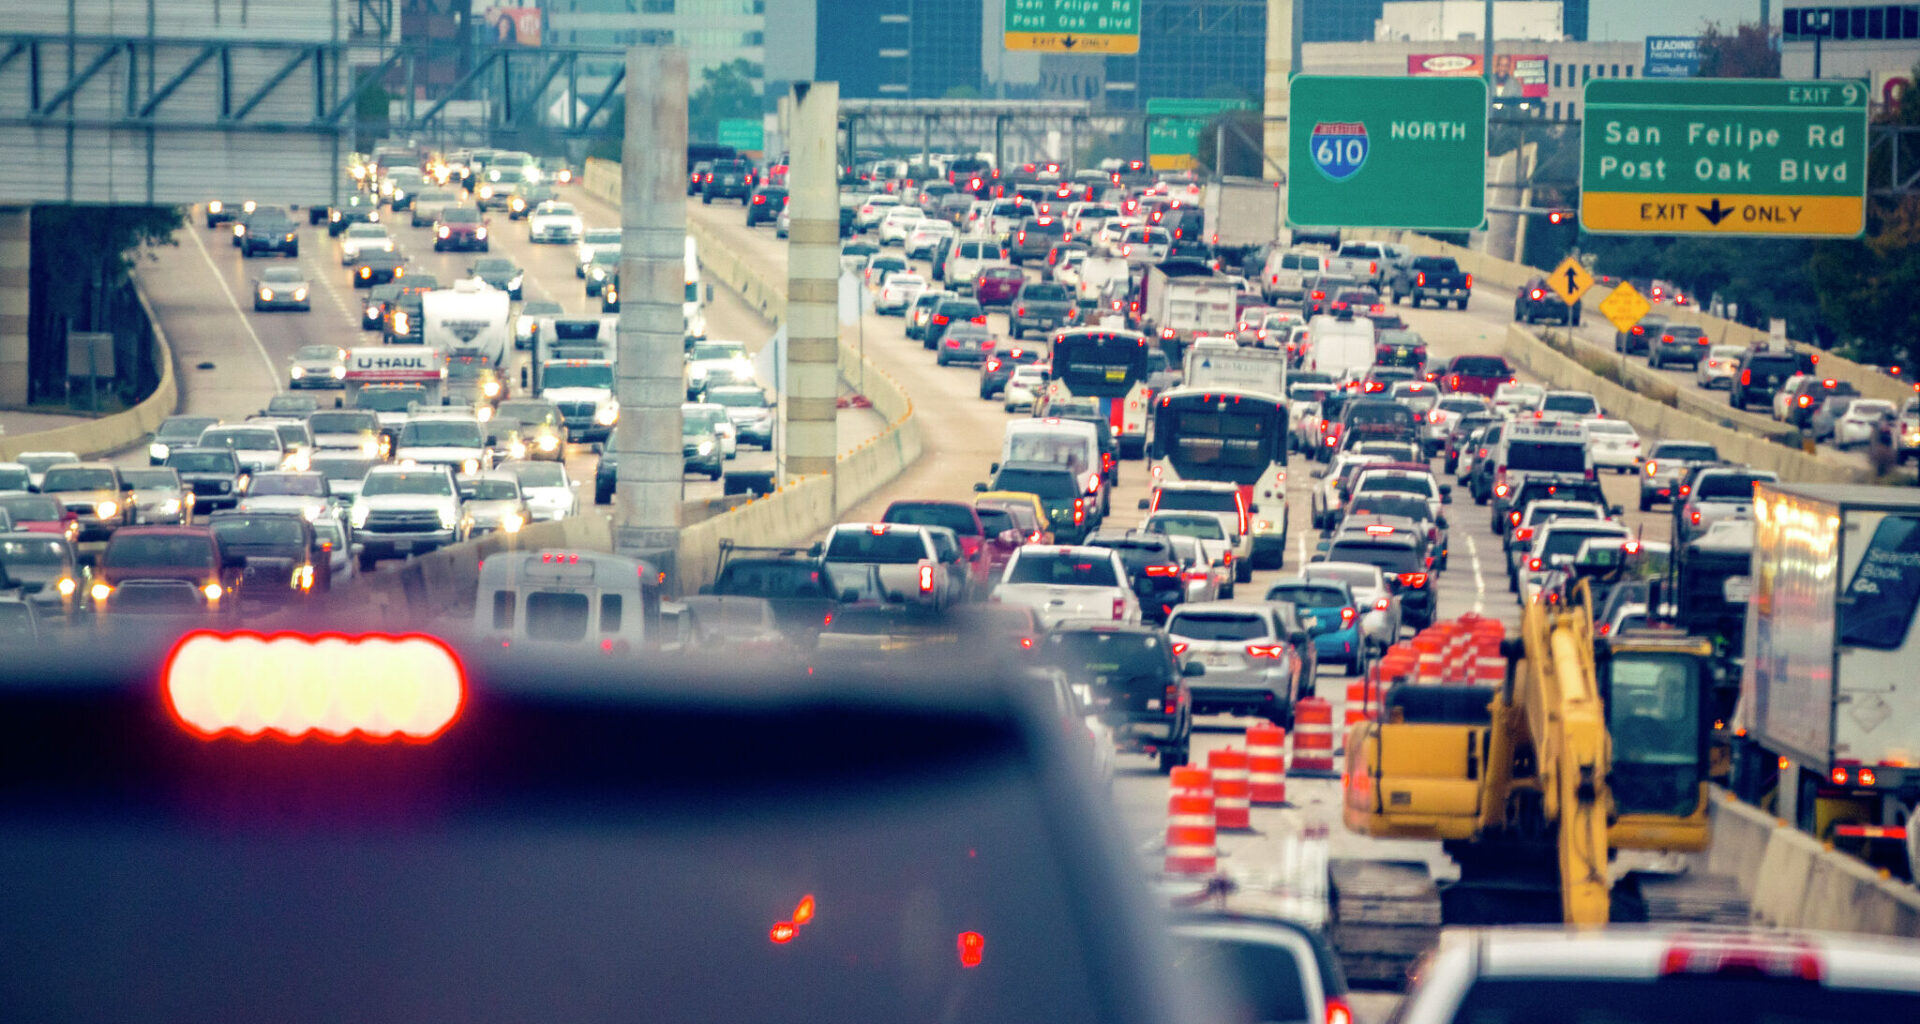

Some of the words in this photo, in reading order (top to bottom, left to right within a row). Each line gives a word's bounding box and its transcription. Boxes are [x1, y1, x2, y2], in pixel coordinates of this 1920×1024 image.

[1016, 0, 1043, 9] San
[1055, 0, 1099, 12] Felipe
[1013, 15, 1045, 27] Post
[1059, 15, 1085, 28] Oak
[1099, 16, 1132, 29] Blvd
[1650, 40, 1696, 50] LEADING
[1788, 87, 1831, 103] EXIT
[1841, 84, 1859, 106] 9
[1390, 121, 1466, 140] NORTH
[1605, 121, 1661, 145] San
[1688, 123, 1780, 150] Felipe
[1808, 125, 1846, 148] Rd
[1317, 139, 1363, 166] 610
[1600, 156, 1666, 180] Post
[1695, 157, 1751, 182] Oak
[1779, 159, 1847, 183] Blvd
[1640, 203, 1688, 220] EXIT
[1742, 205, 1803, 223] ONLY
[357, 357, 427, 369] U-HAUL
